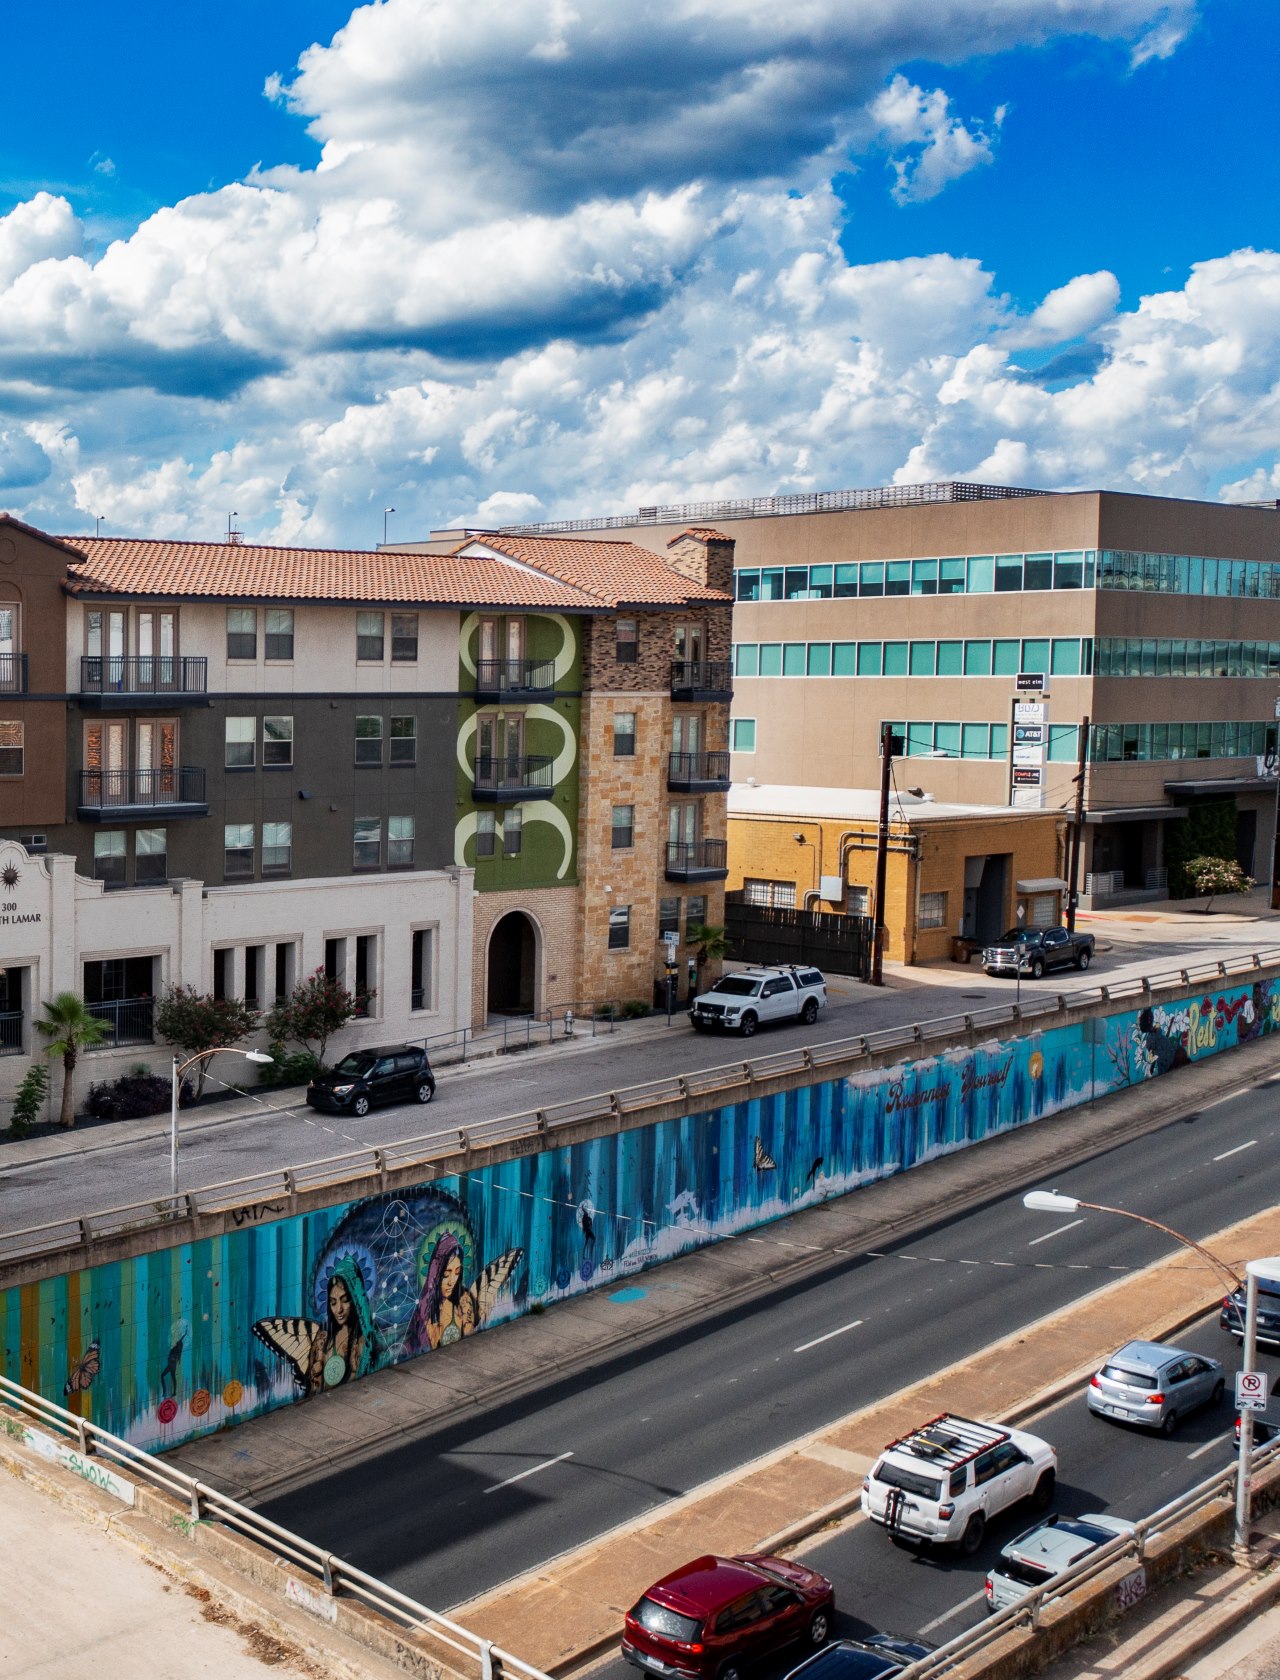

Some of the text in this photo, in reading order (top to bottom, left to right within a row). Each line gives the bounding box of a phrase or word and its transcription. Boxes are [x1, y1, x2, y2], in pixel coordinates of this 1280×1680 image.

[1024, 730, 1042, 738] AT&T
[1, 902, 17, 912] 300
[11, 913, 41, 924] LAMAR
